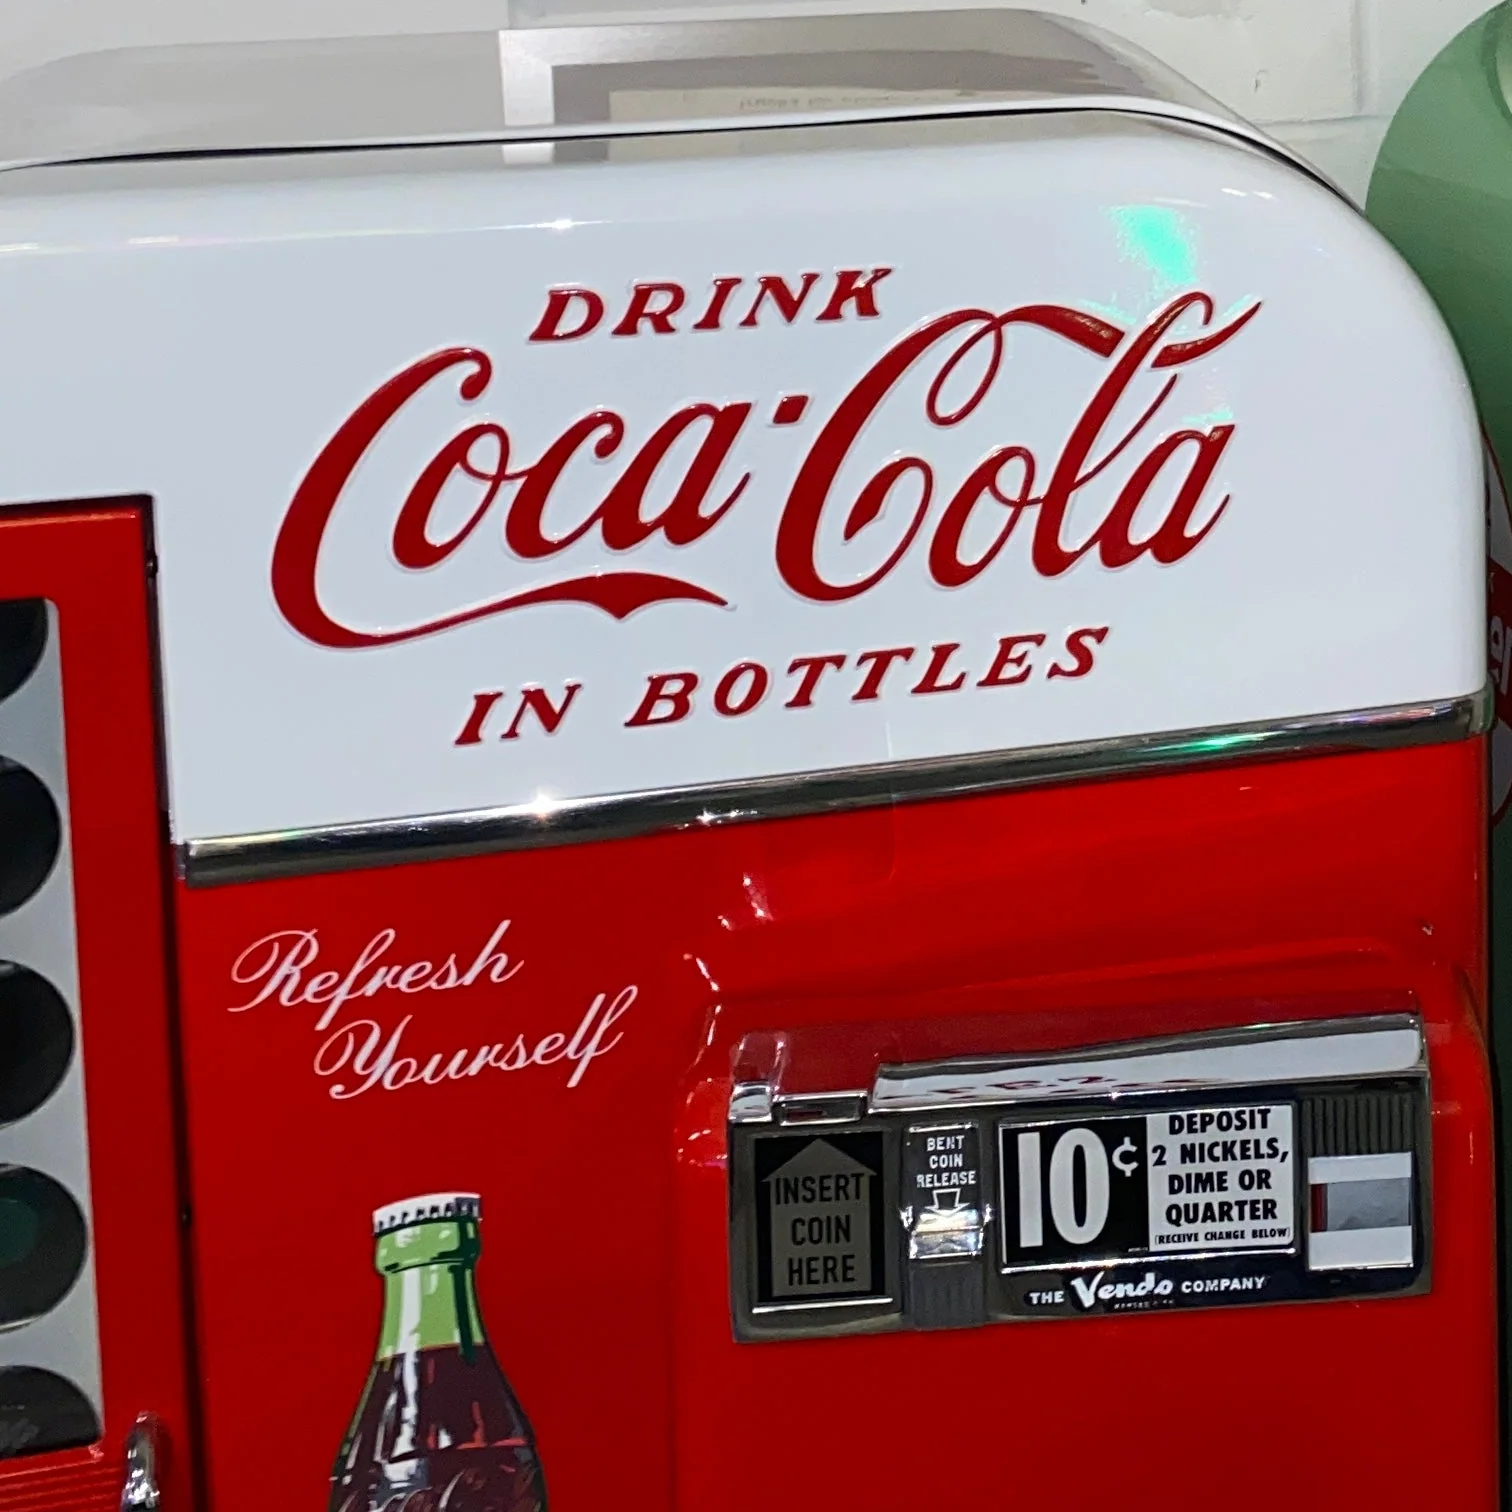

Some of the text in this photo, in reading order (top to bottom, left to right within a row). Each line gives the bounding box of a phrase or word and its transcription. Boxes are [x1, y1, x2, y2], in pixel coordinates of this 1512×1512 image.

[526, 266, 897, 344] DRINK
[453, 624, 1110, 746] IN BOTTLES
[227, 919, 525, 1032] Refresh
[313, 985, 639, 1099] Yourself
[1168, 1108, 1271, 1135] DEPOSIT
[926, 1135, 965, 1151] BENT
[1151, 1137, 1289, 1166] 2 NICKELS,
[929, 1153, 964, 1169] COIN
[775, 1172, 865, 1205] INSERT
[916, 1171, 977, 1188] RELEASE
[1168, 1169, 1272, 1195] DIME OR
[1165, 1199, 1278, 1227] QUARTER
[791, 1214, 851, 1246] COIN
[1204, 1229, 1245, 1241] CHANGE
[788, 1254, 856, 1286] HERE
[1029, 1290, 1065, 1305] THE
[1071, 1271, 1174, 1309] Vendo
[1181, 1276, 1266, 1293] COMPANY
